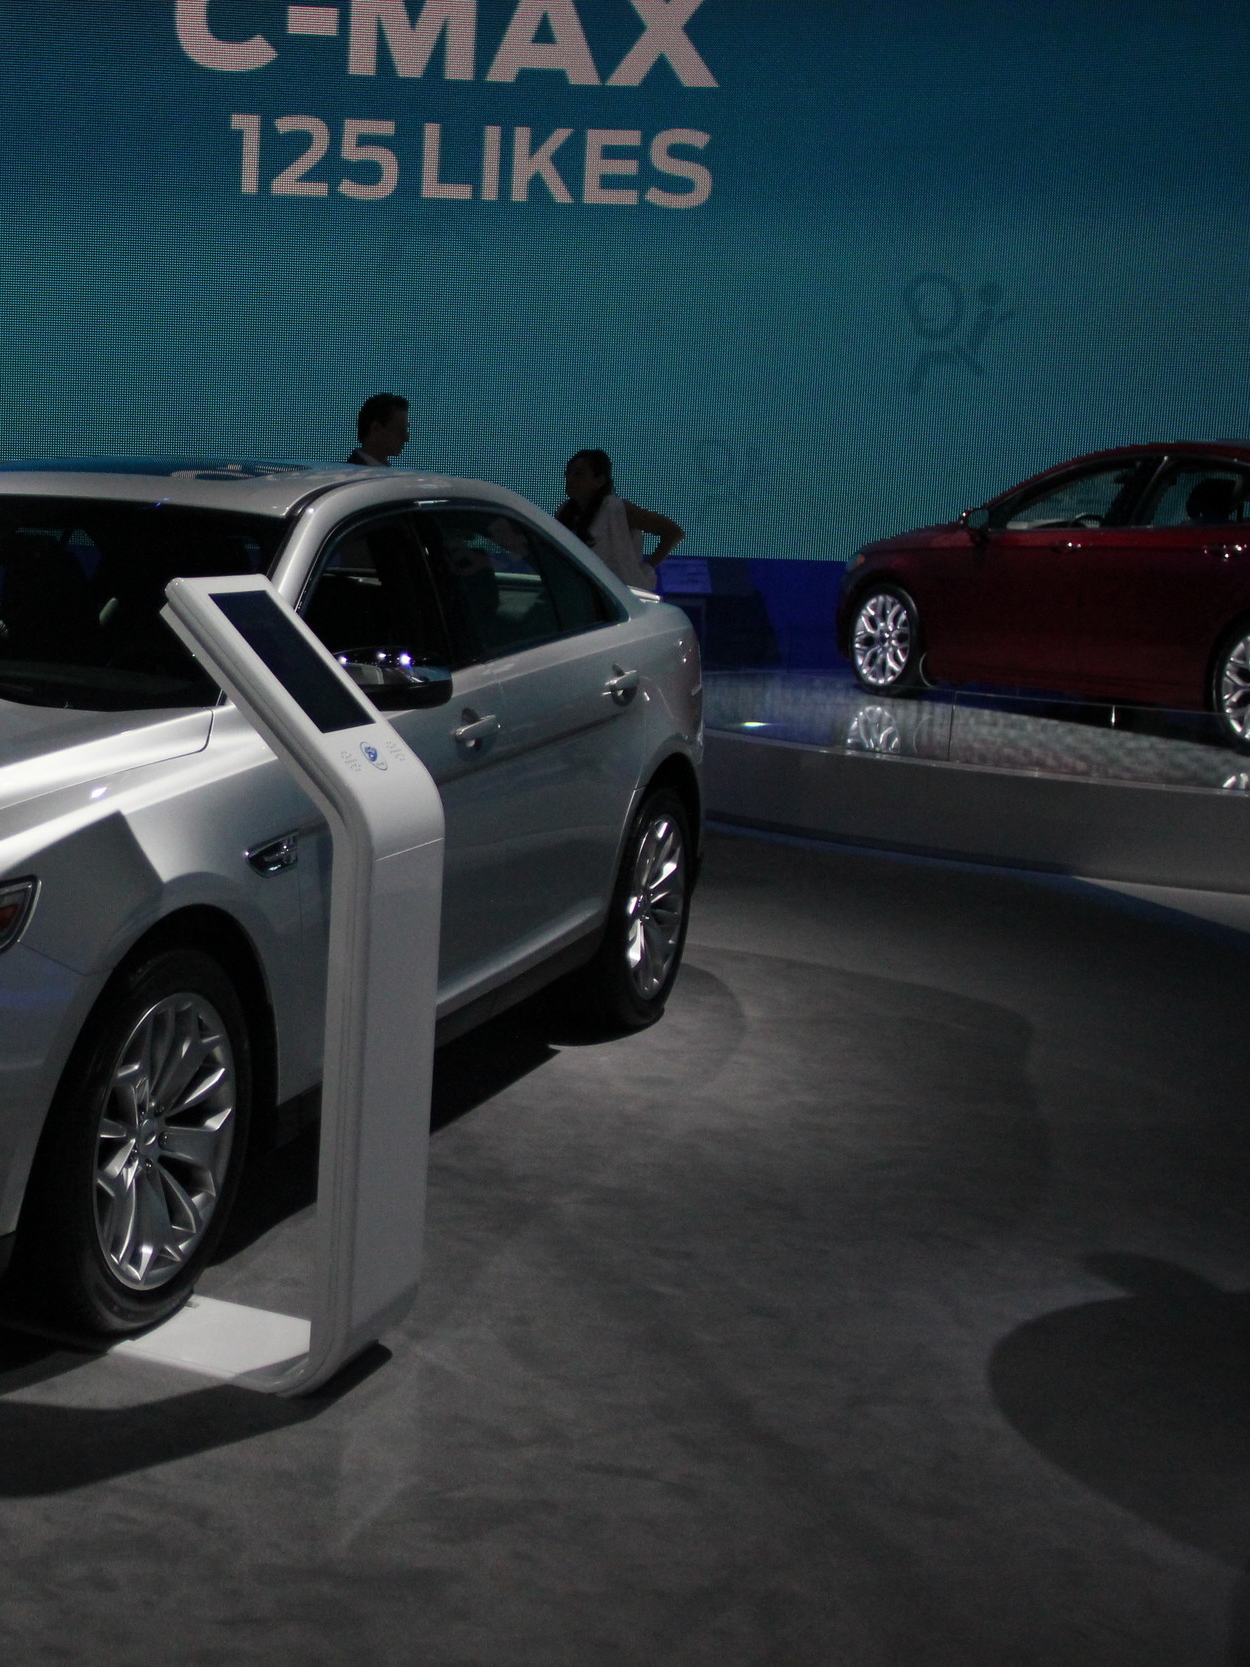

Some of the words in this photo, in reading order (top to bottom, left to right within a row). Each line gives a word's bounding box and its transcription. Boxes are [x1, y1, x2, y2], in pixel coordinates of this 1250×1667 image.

[175, 0, 719, 88] C-MAX
[230, 113, 399, 200] 125
[421, 122, 713, 209] LIKES
